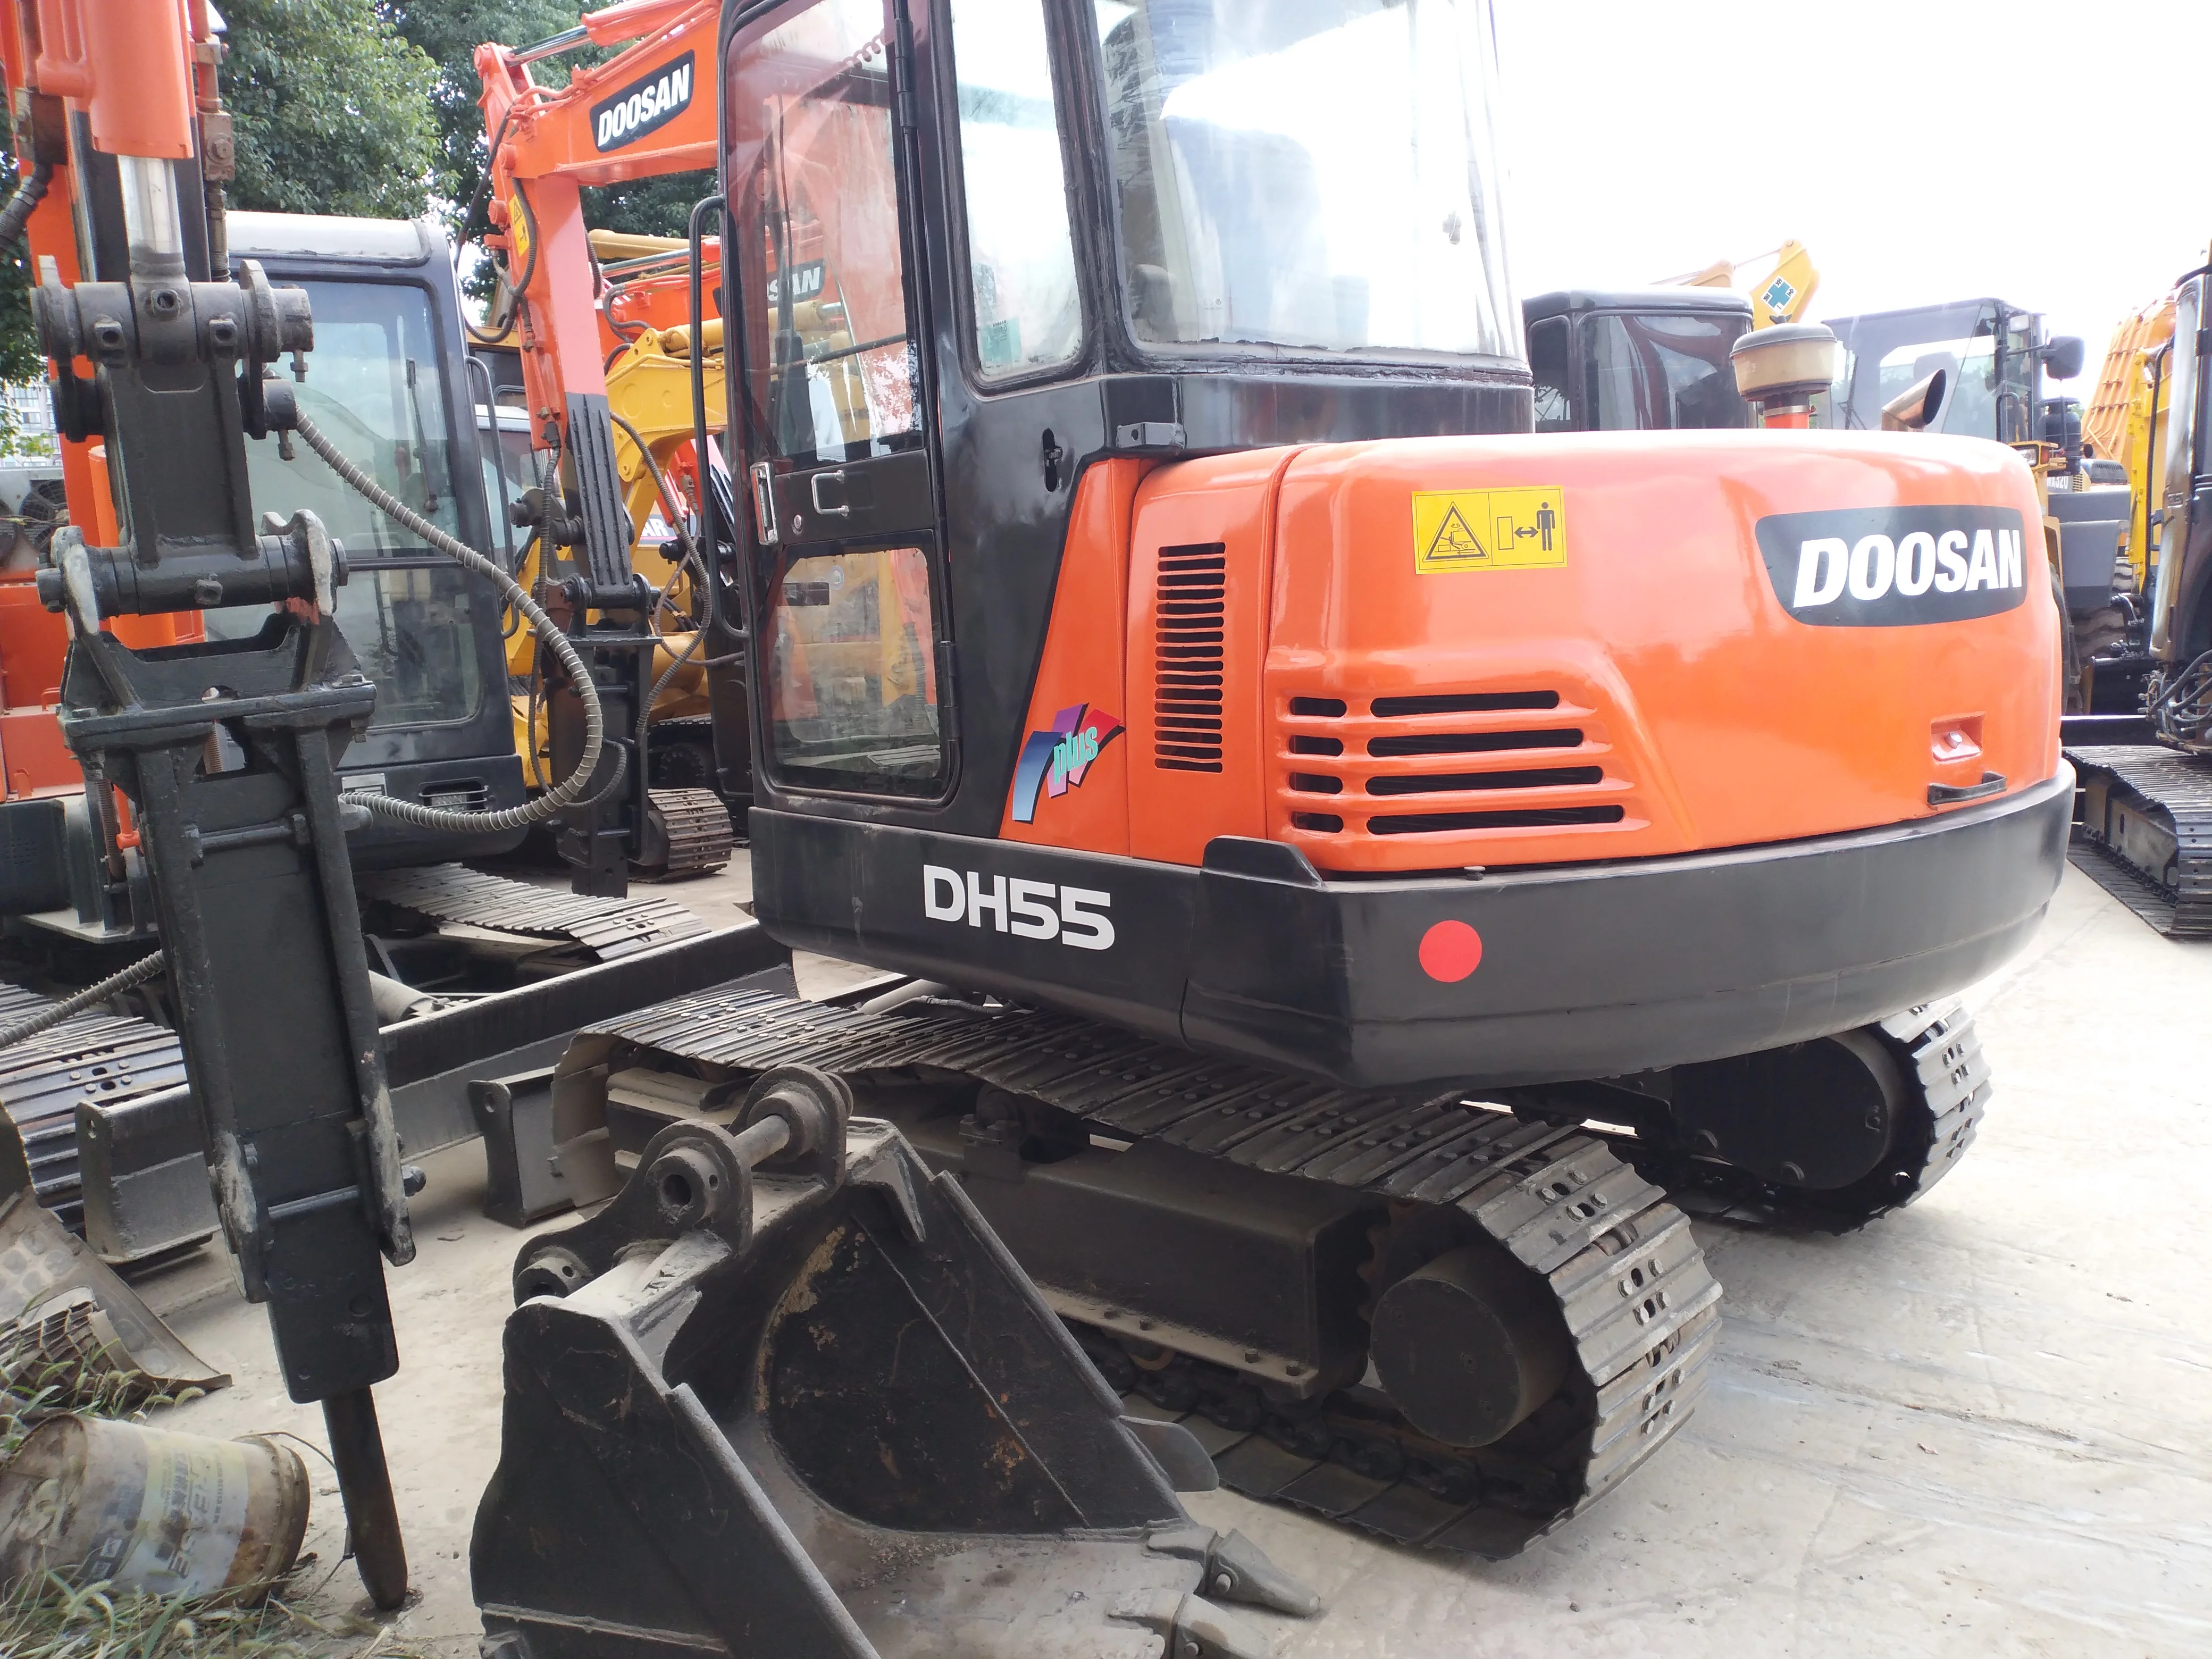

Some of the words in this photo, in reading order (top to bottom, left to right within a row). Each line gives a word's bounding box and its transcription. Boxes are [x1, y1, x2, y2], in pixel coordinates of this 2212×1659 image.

[598, 63, 690, 147] DOOSAN
[1793, 529, 2022, 608] DOOSAN
[1053, 726, 1099, 785] plus
[924, 865, 1115, 950] DH55
